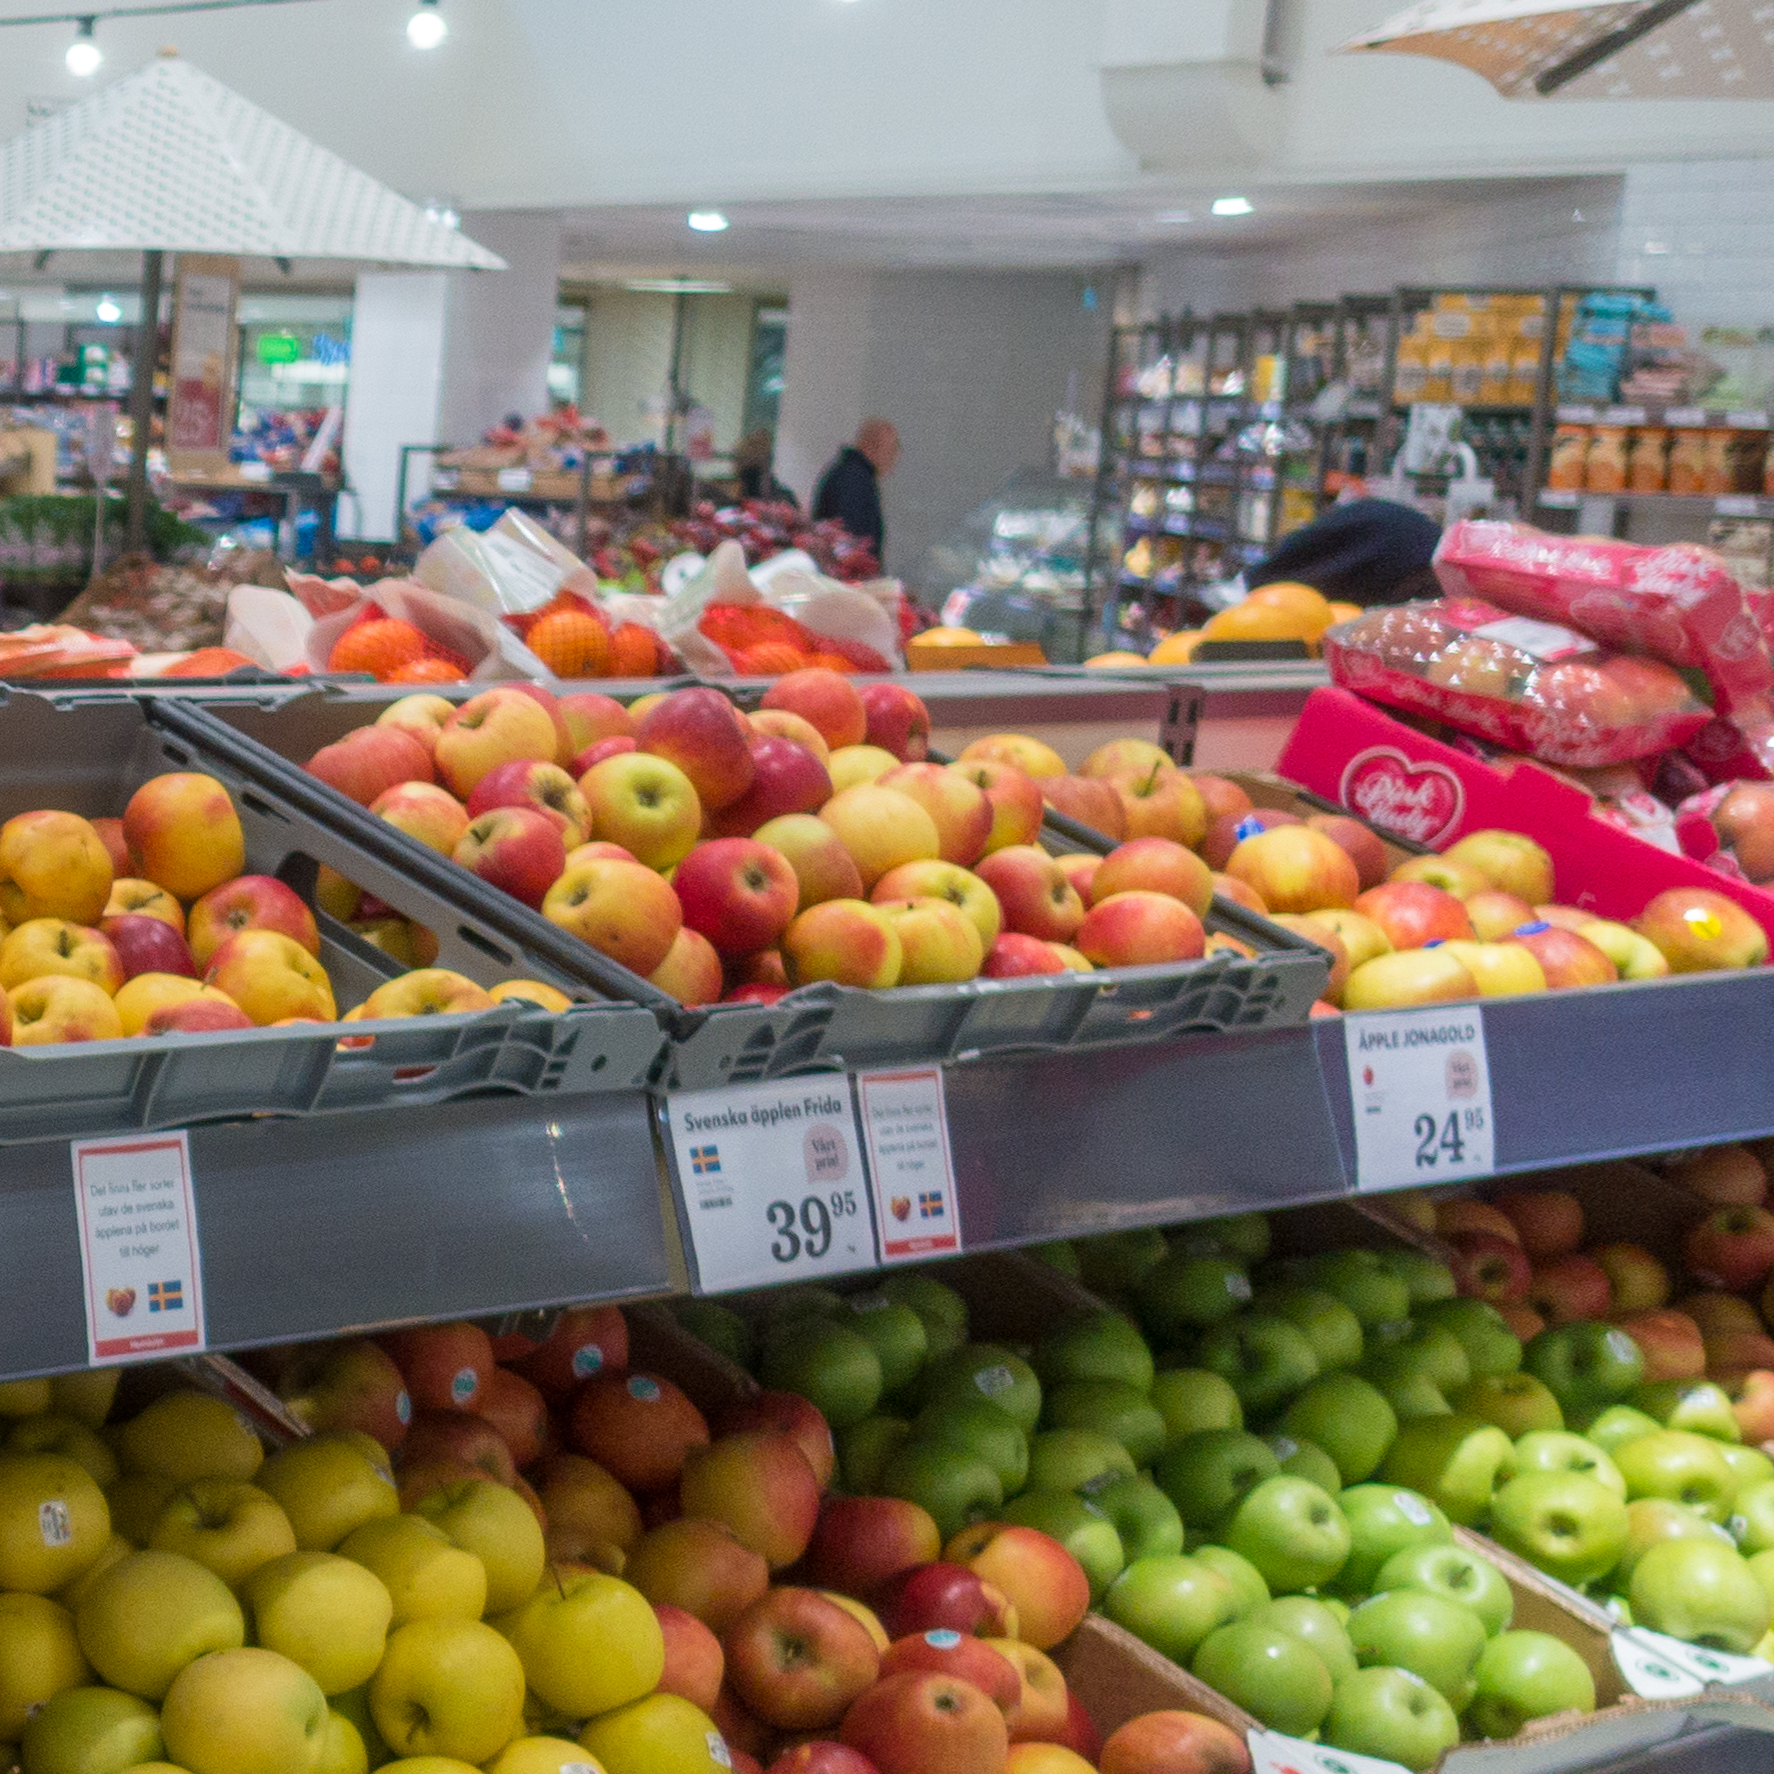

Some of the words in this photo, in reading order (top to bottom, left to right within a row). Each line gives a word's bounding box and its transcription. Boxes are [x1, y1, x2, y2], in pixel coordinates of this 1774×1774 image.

[1359, 1029, 1403, 1051] ÄPPLE
[1404, 1025, 1476, 1046] JONAGOLD
[685, 1107, 746, 1134] Svenska
[749, 1102, 802, 1131] äpplen
[804, 1098, 843, 1119] Frida
[1414, 1110, 1466, 1166] 24
[137, 1200, 174, 1213] svenska
[767, 1195, 832, 1265] 39
[833, 1192, 858, 1219] 95
